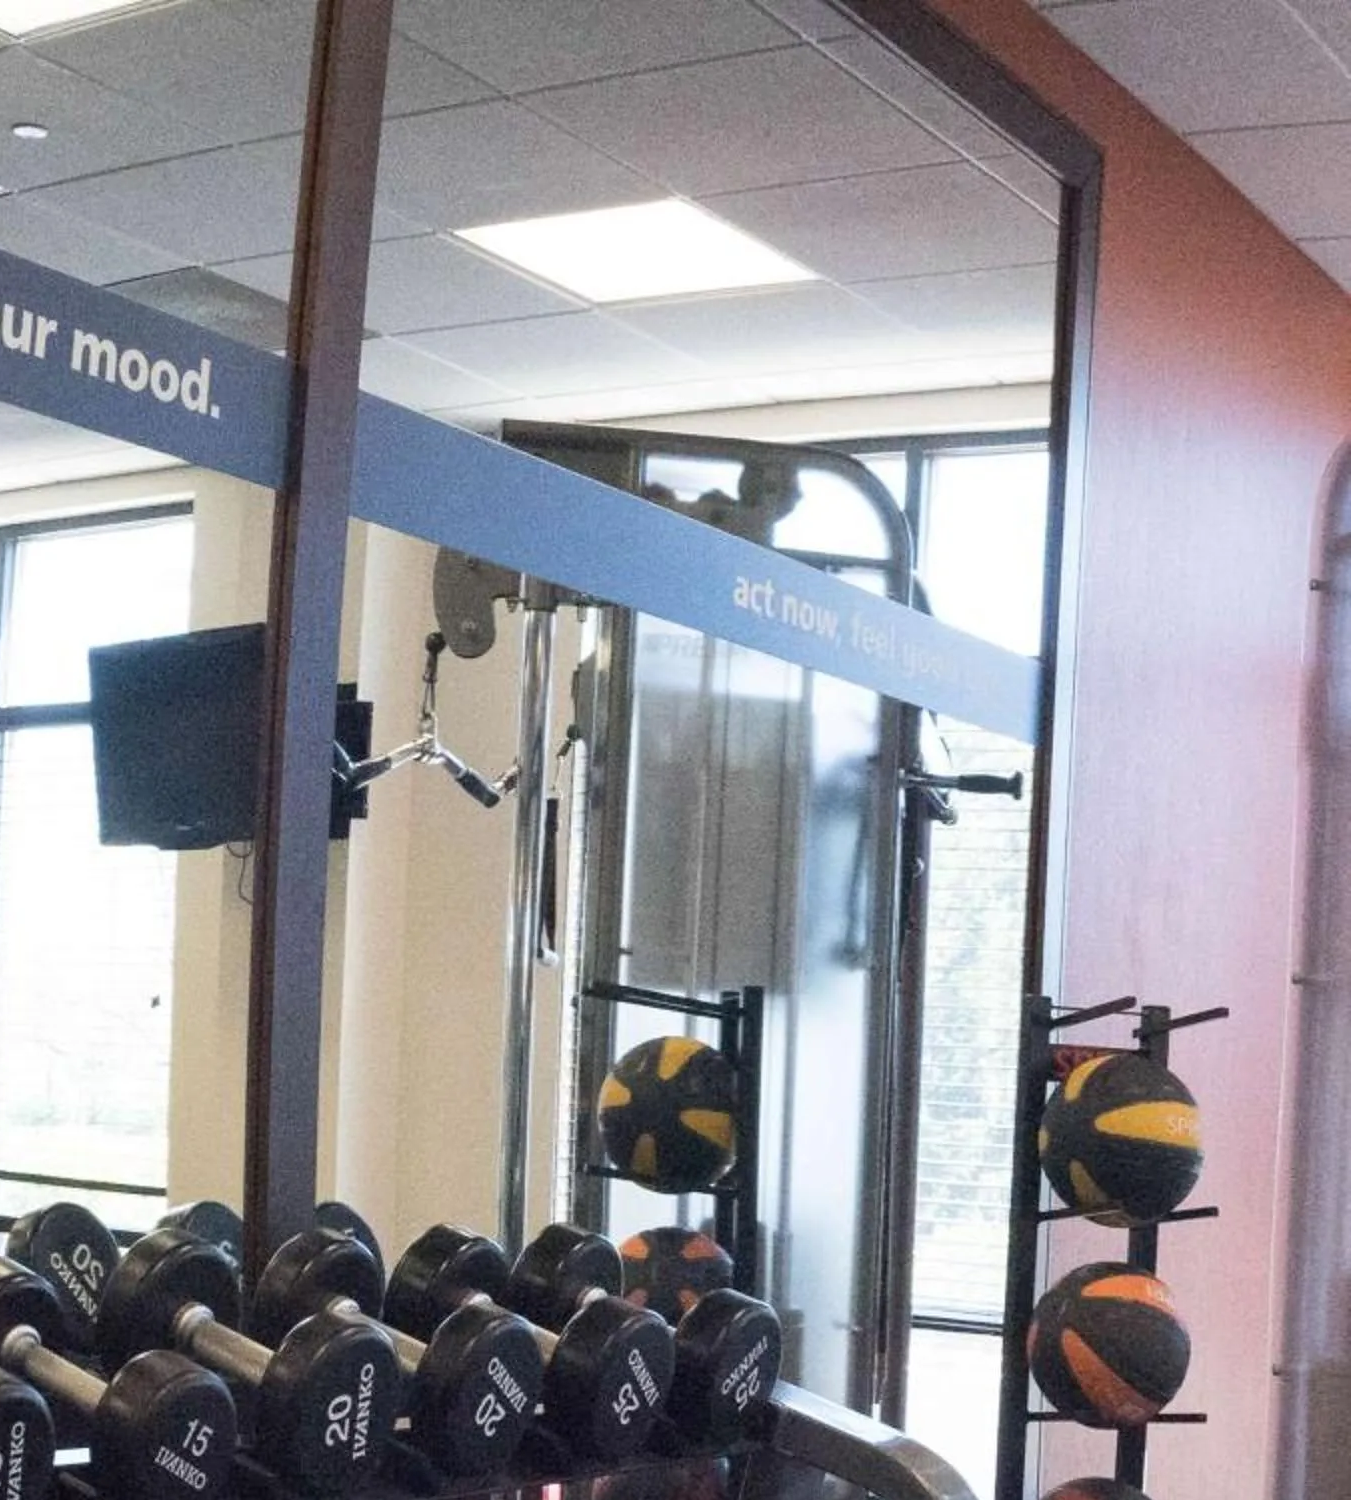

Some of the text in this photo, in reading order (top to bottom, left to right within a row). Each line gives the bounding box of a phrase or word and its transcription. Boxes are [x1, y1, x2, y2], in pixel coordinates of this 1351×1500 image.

[70, 325, 222, 420] mood.
[733, 575, 775, 619] act
[781, 594, 842, 649] now,
[488, 1357, 528, 1416] IVANKO
[612, 1383, 639, 1425] 25
[628, 1349, 658, 1408] IVANKO
[735, 1367, 761, 1411] 25
[181, 1417, 214, 1458] 15
[325, 1395, 352, 1447] 20
[352, 1363, 375, 1460] IVANKO
[474, 1394, 506, 1437] 20
[155, 1446, 207, 1490] IVANKO
